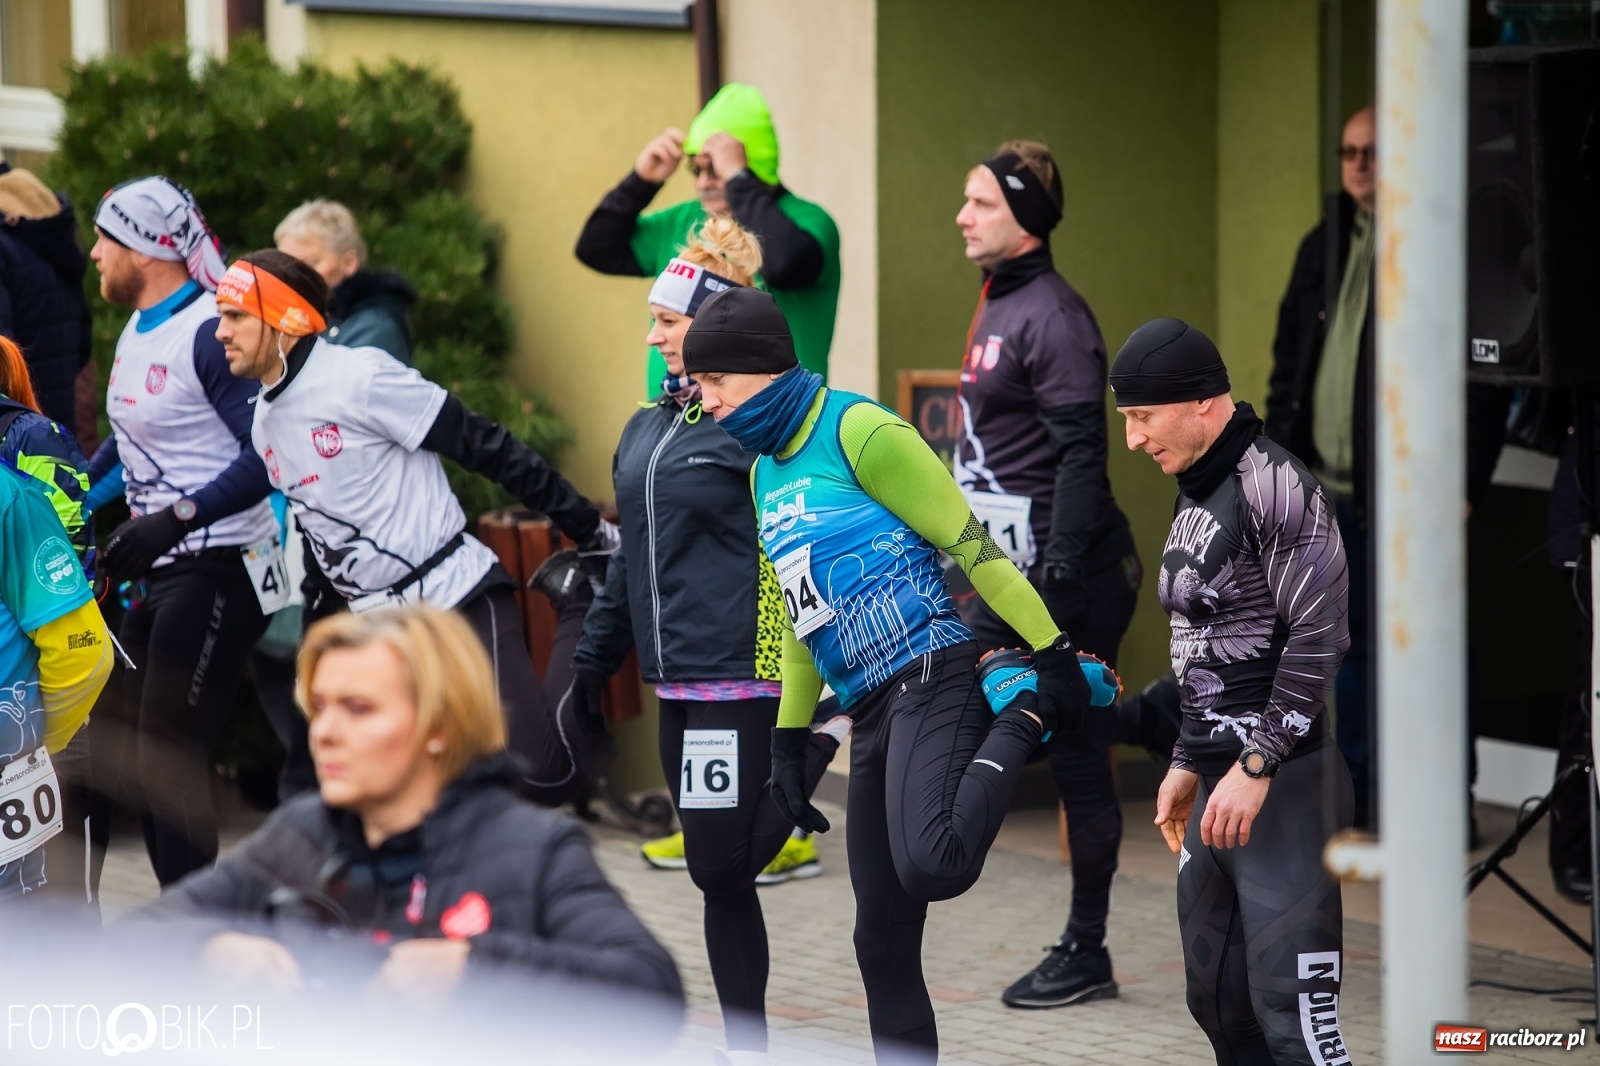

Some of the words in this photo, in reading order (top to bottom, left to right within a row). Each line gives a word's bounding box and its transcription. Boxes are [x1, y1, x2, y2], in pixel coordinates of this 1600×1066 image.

[996, 668, 1037, 692] salomon
[683, 758, 731, 793] 16
[0, 783, 56, 841] 80
